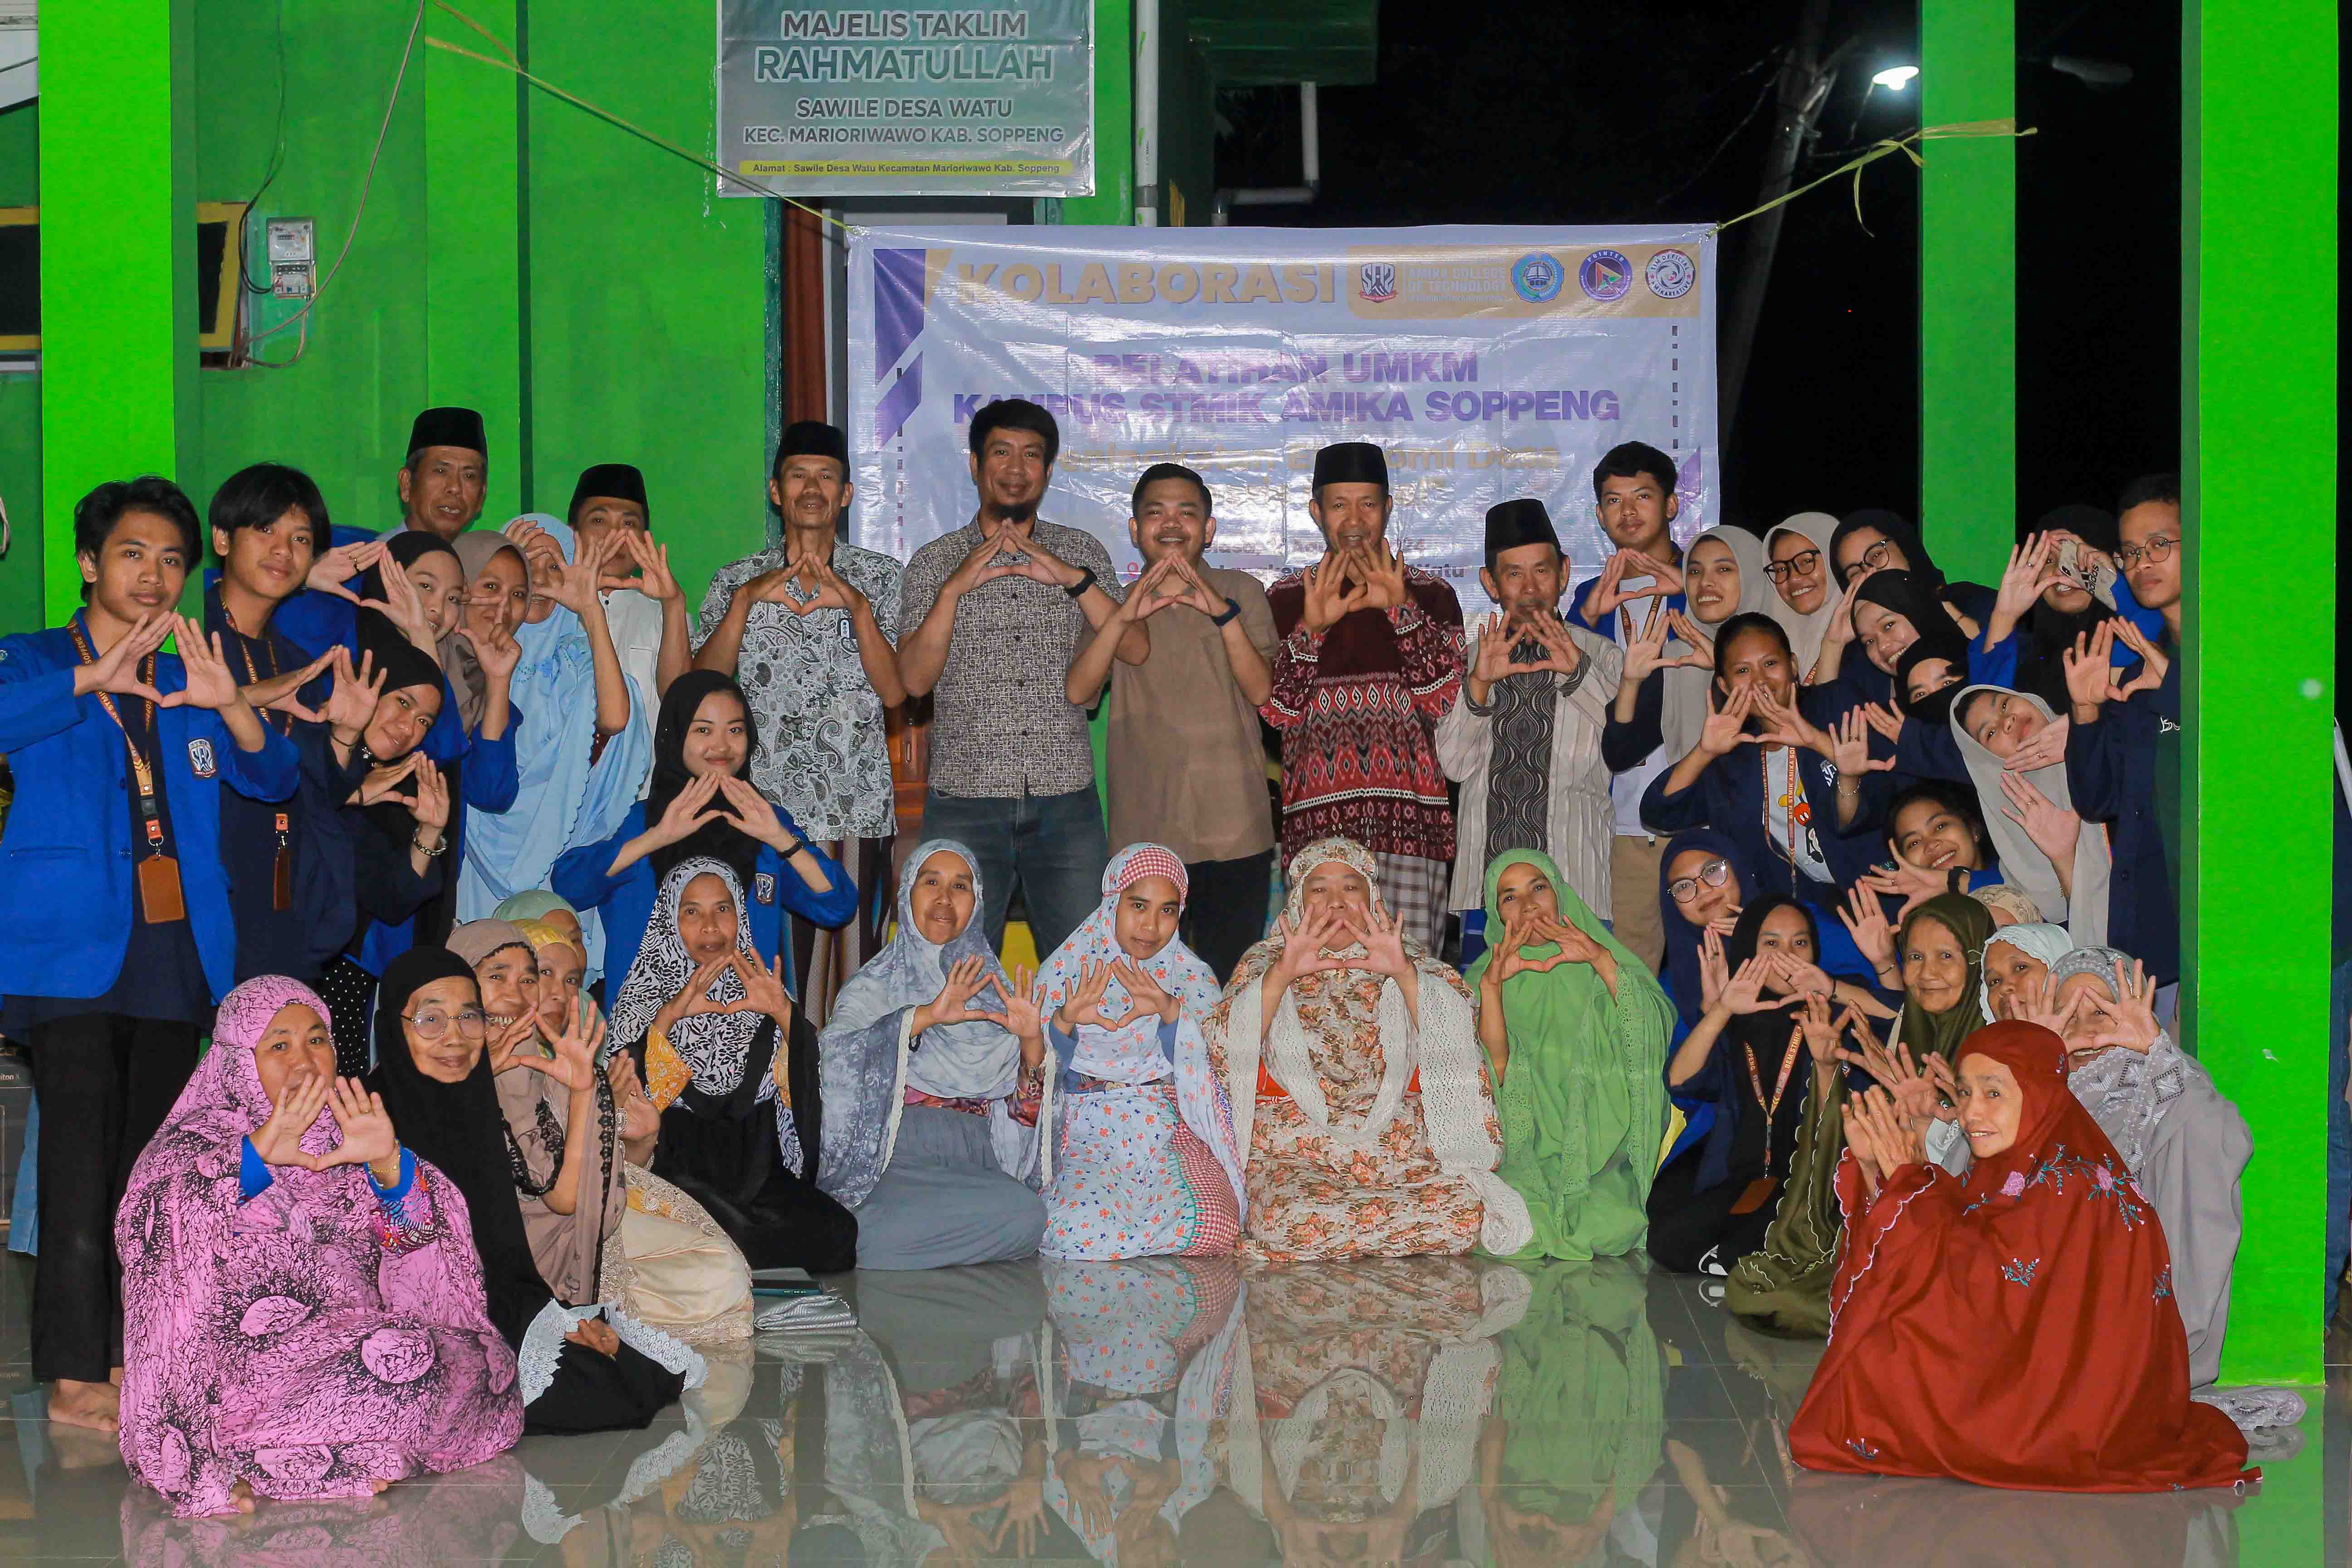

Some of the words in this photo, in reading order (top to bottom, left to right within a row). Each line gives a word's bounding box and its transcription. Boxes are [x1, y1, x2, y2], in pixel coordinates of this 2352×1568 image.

[784, 13, 907, 37] MAJELIS
[916, 13, 1026, 37] TAKLIM
[758, 49, 1051, 80] RAHMATULLAH
[797, 99, 878, 118] SAWILE
[885, 99, 943, 117] DESA
[951, 99, 1012, 117] WATU
[745, 128, 784, 142] KEC.
[790, 127, 926, 142] MARIORIWAWO
[931, 127, 972, 142] KAB.
[977, 127, 1064, 142] SOPPENG
[753, 164, 786, 172] Alamat
[794, 164, 824, 172] Sawile
[827, 164, 850, 172] Desa
[853, 164, 877, 172] Watu
[879, 164, 930, 172] Kecamatan
[933, 164, 992, 172] Marioriwawo
[994, 164, 1015, 172] Kab.
[1018, 164, 1059, 175] Soppeng
[956, 263, 1335, 304] KOLABORASI
[1343, 353, 1478, 382] UMKM
[1139, 392, 1268, 422] STMIK
[1281, 392, 1414, 421] AMIKA
[1425, 390, 1620, 421] SOPPENG
[75, 636, 91, 665] SOPPENG
[1785, 1054, 1793, 1069] BEM
[1790, 1031, 1801, 1053] STMIK
